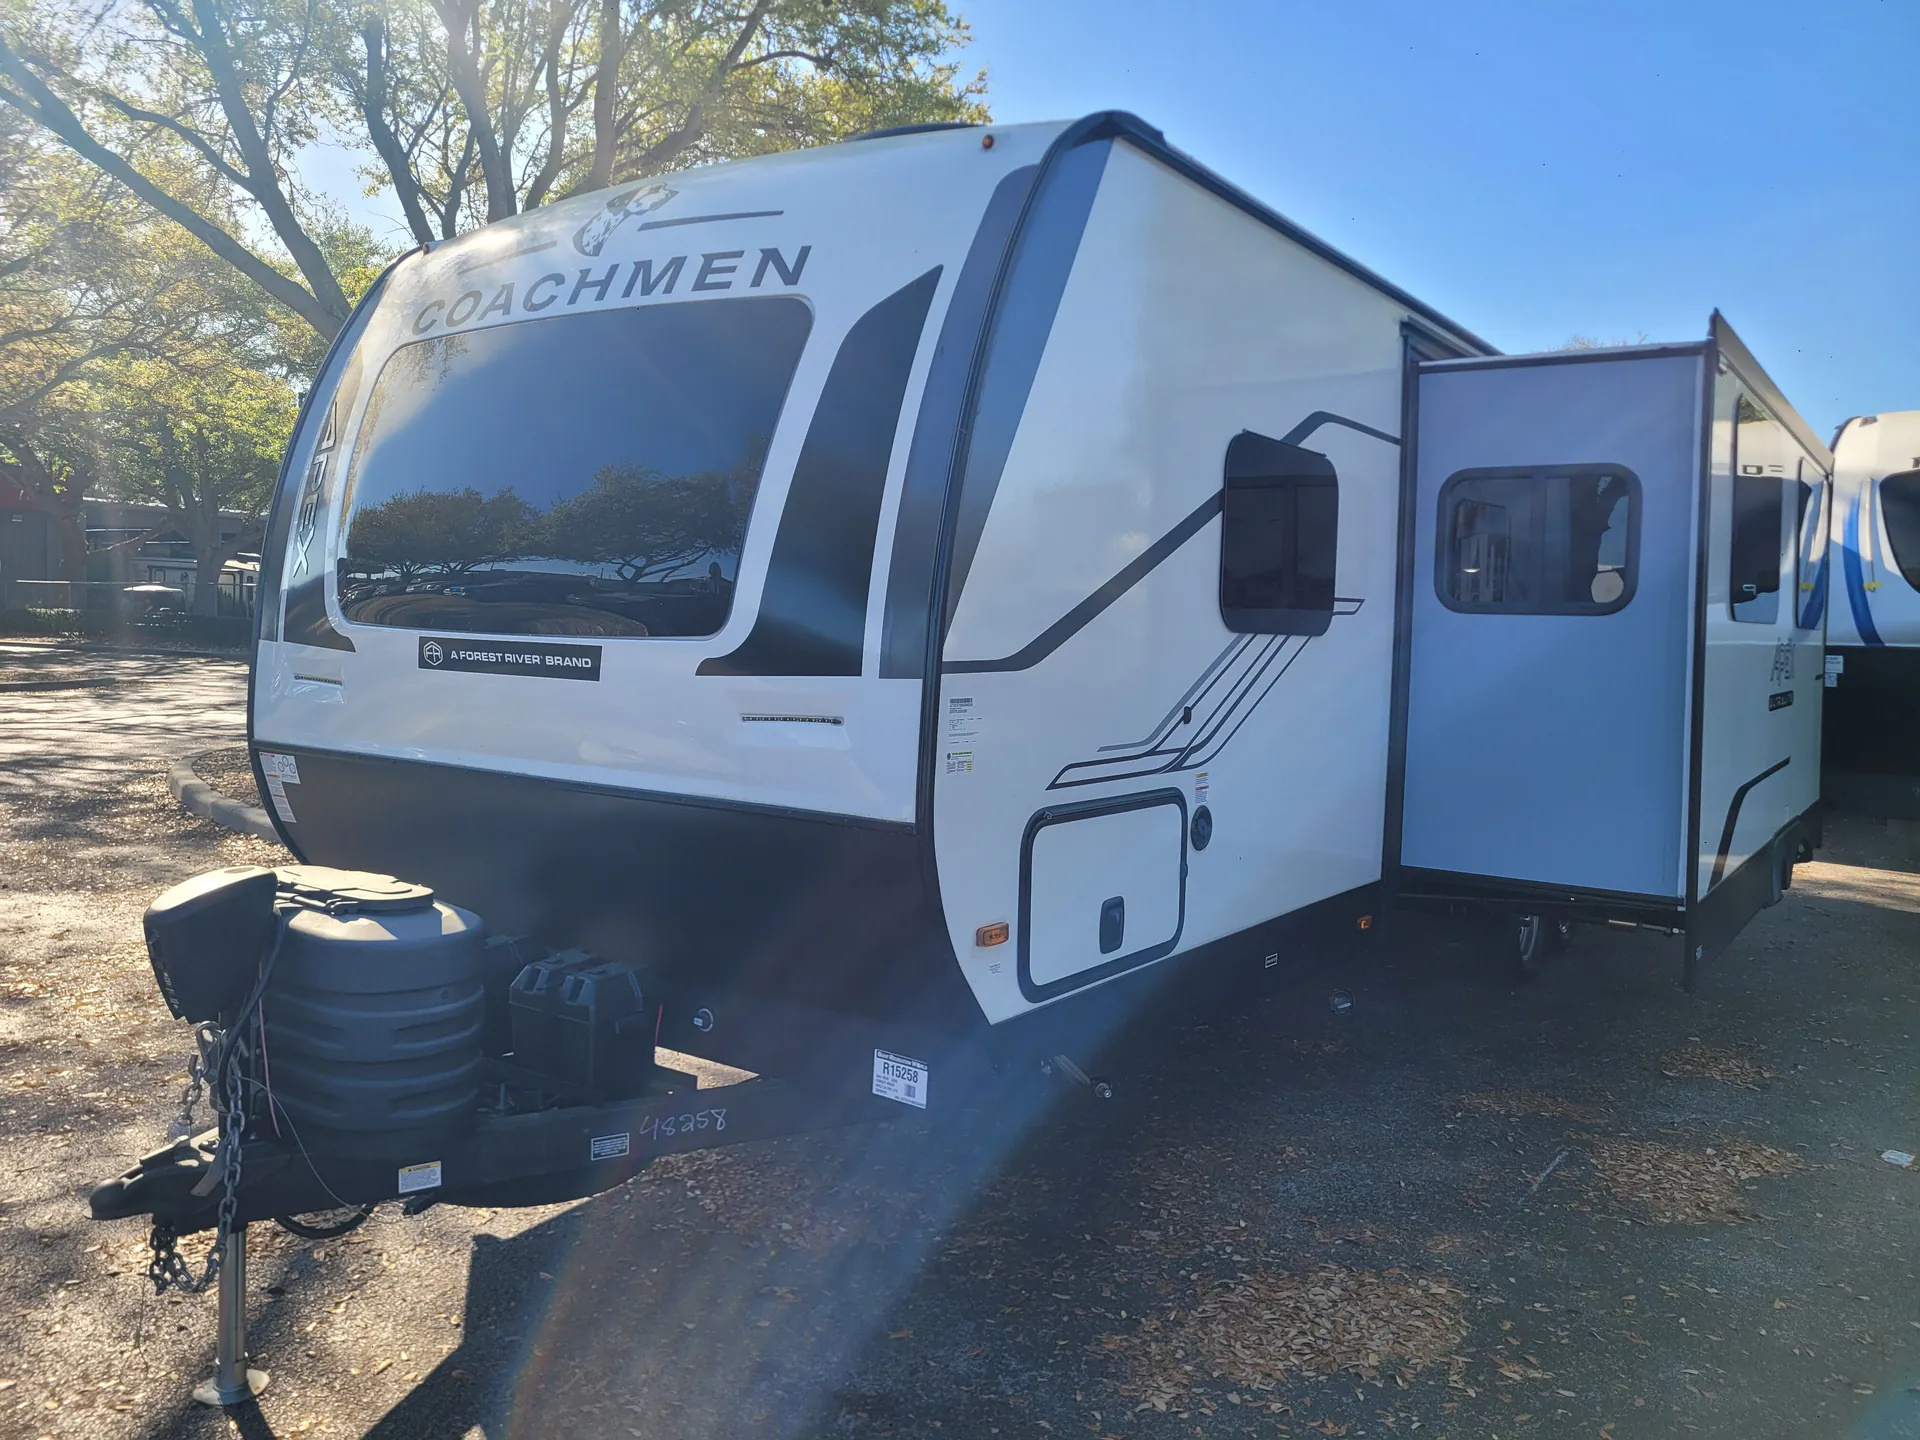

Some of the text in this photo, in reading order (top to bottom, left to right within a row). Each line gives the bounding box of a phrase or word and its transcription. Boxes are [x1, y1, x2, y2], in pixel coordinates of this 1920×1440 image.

[411, 244, 812, 336] COACHMEN
[450, 650, 592, 668] A FOREST RIVER BRAND
[882, 1061, 919, 1084] R15258
[639, 1108, 727, 1141] 48258
